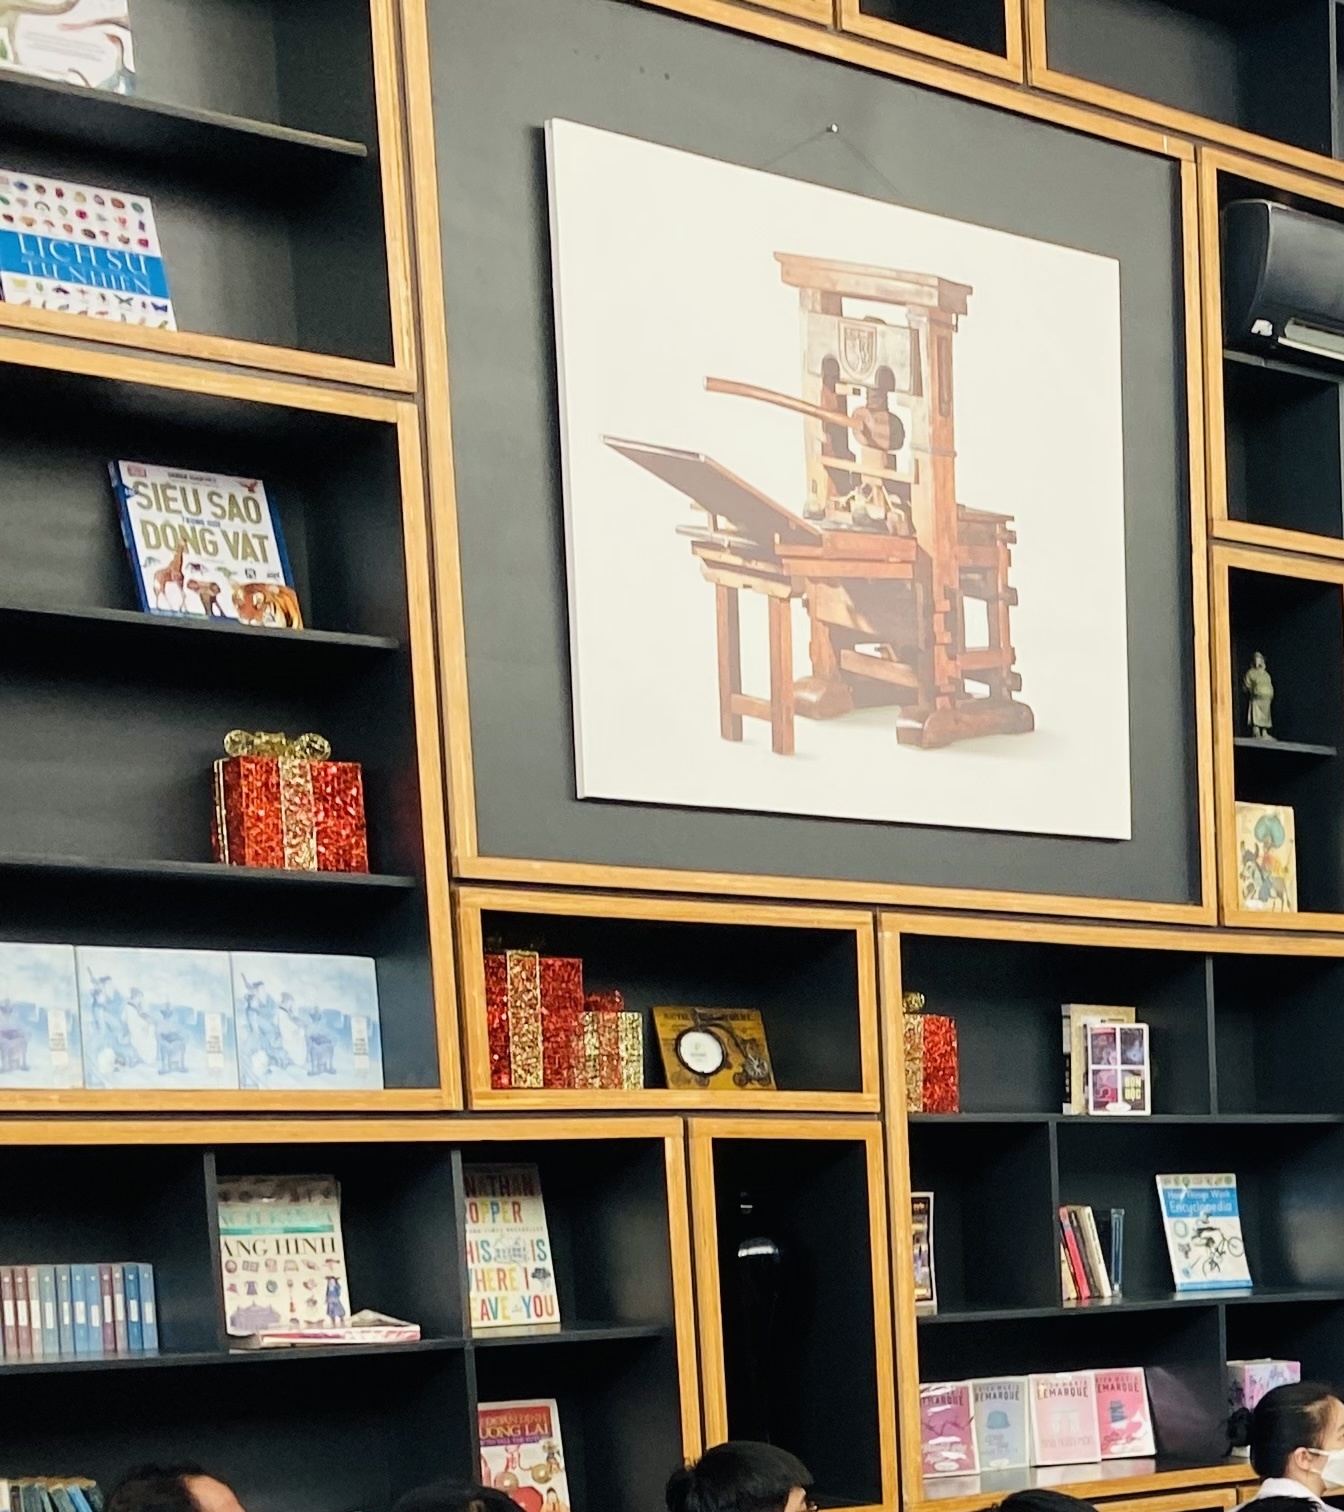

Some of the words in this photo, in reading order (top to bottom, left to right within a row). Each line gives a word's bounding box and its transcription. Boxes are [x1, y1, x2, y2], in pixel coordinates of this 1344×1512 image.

[207, 490, 262, 525] SAO
[468, 1200, 523, 1225] OPPER
[1169, 1200, 1233, 1217] Encyclopedia
[467, 1239, 492, 1265] HIS
[530, 1238, 548, 1262] IS
[468, 1267, 519, 1293] HERE
[470, 1295, 512, 1322] EAVE
[521, 1294, 555, 1320] YOU
